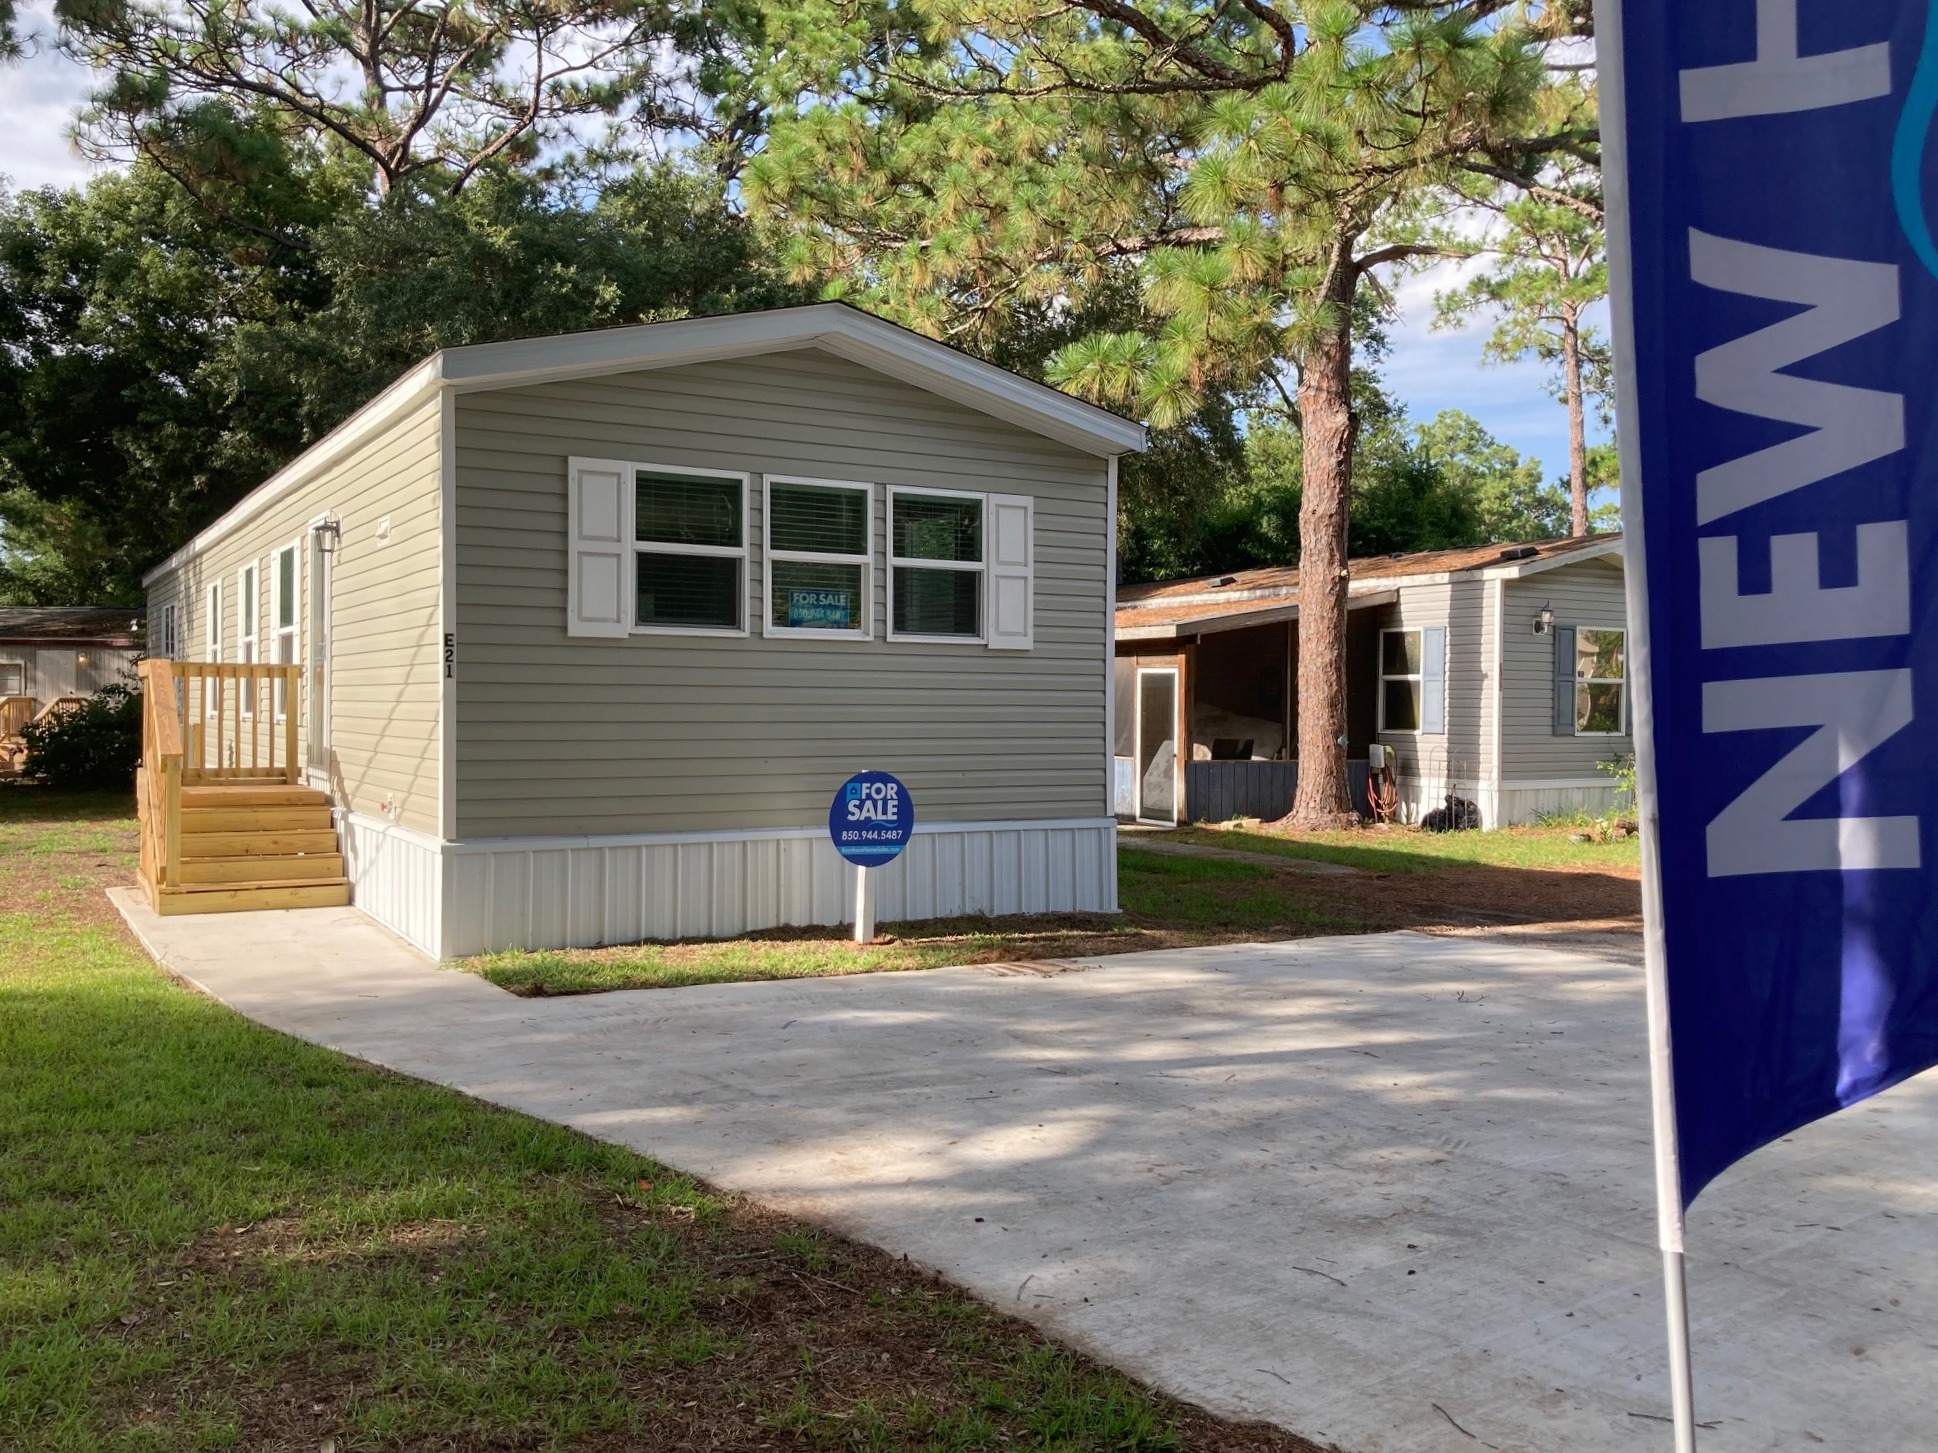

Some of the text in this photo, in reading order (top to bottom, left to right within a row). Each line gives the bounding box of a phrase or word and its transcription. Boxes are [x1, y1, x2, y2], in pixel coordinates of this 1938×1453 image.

[1687, 226, 1921, 878] NEW
[793, 592, 846, 606] FOR SALE
[444, 633, 454, 678] E21
[861, 782, 898, 799] FOR
[847, 799, 898, 820] SALE
[841, 830, 903, 840] 850.944.5487
